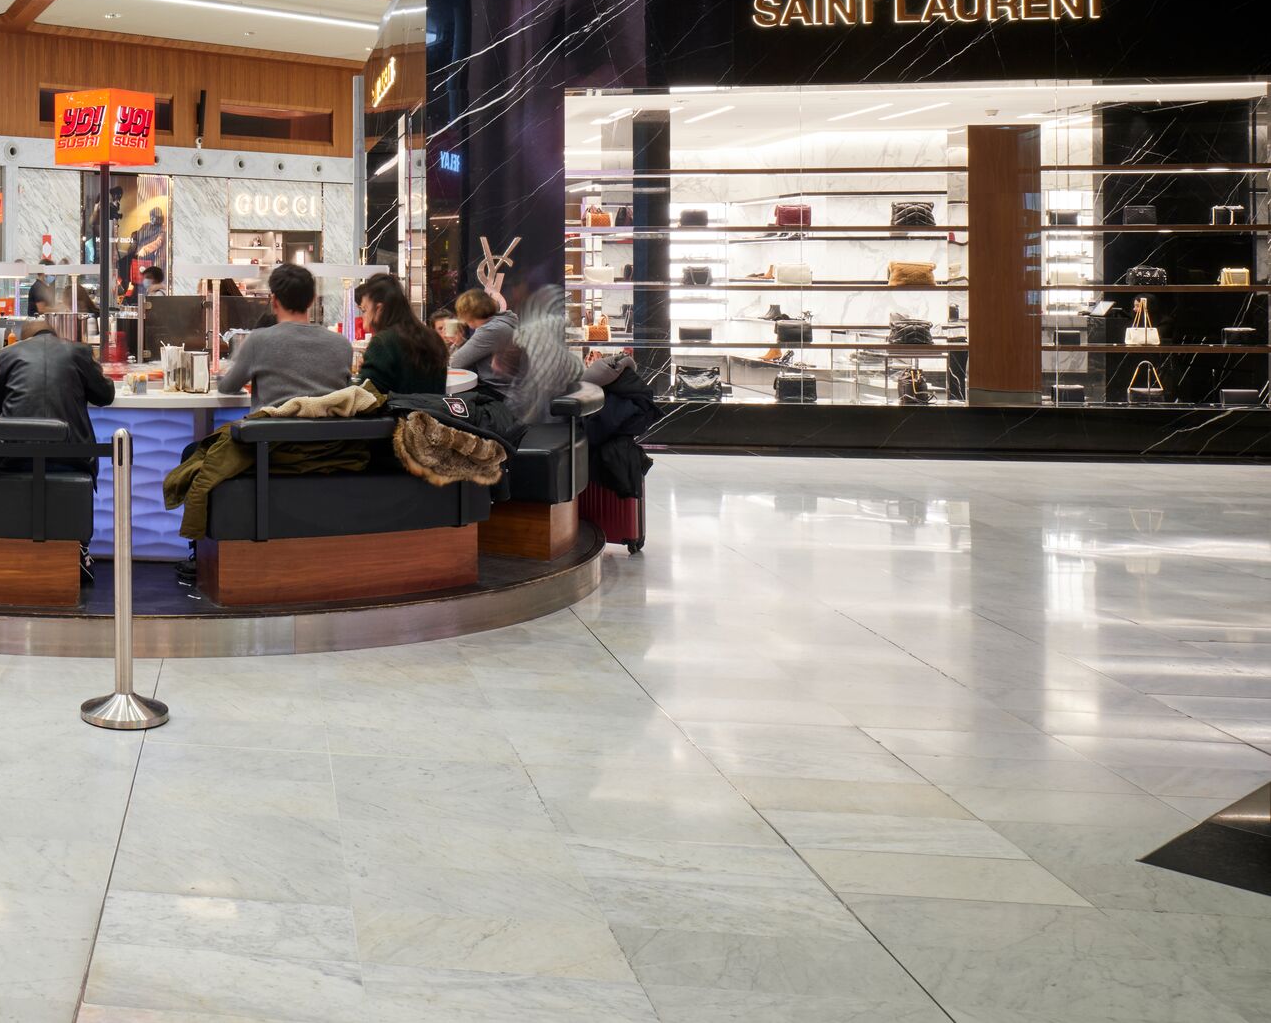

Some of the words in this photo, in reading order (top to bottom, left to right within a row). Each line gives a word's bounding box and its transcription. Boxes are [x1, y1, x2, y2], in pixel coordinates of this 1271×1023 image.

[60, 105, 107, 138] YO!
[115, 105, 154, 138] YO!
[235, 193, 317, 217] GUCCI
